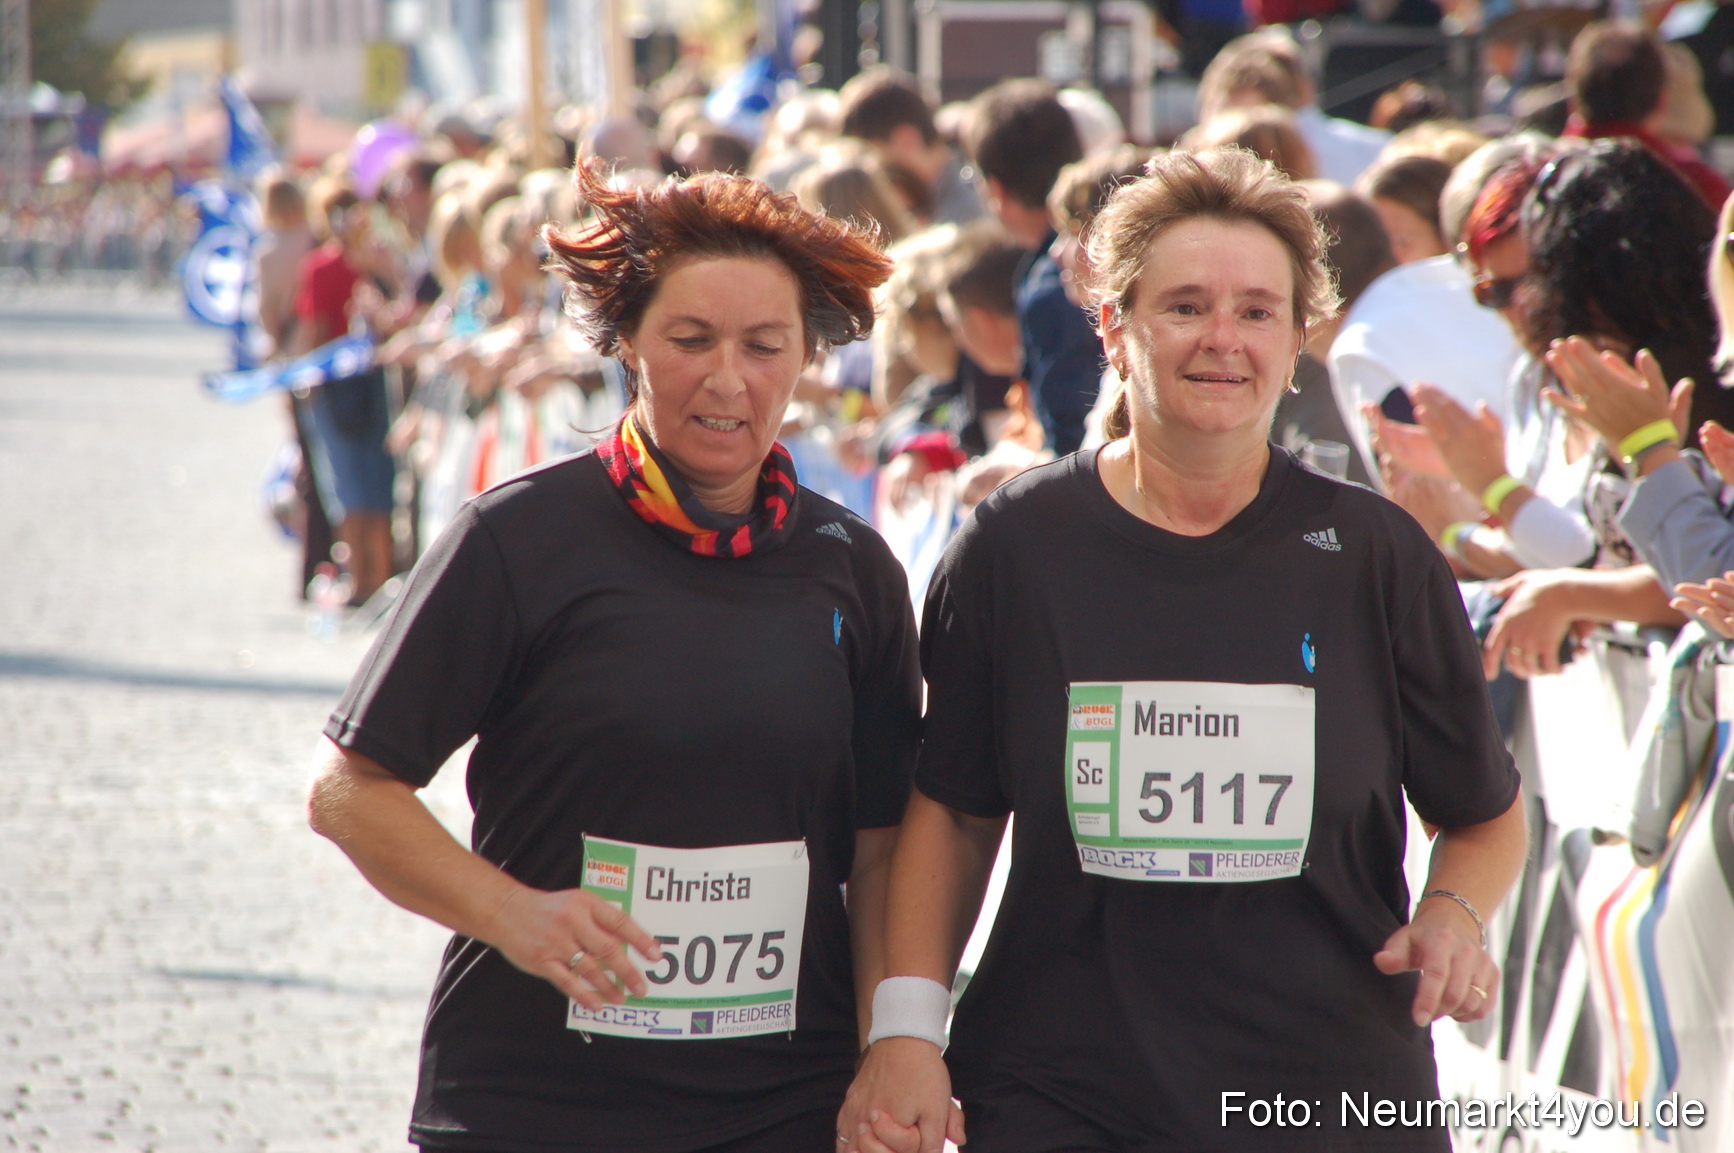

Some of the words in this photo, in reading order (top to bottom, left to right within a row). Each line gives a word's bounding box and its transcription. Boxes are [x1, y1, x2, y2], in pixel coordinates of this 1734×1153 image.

[815, 527, 852, 545] adidas
[1303, 534, 1342, 551] adidas
[1133, 700, 1239, 737] Marion
[1077, 759, 1103, 784] Sc
[1138, 772, 1293, 825] 5117
[1081, 847, 1157, 869] BOCK
[1216, 852, 1300, 868] PFLEIDERER
[645, 866, 751, 902] Christa
[645, 930, 785, 985] 5075
[716, 1003, 792, 1025] PFLEIDERER
